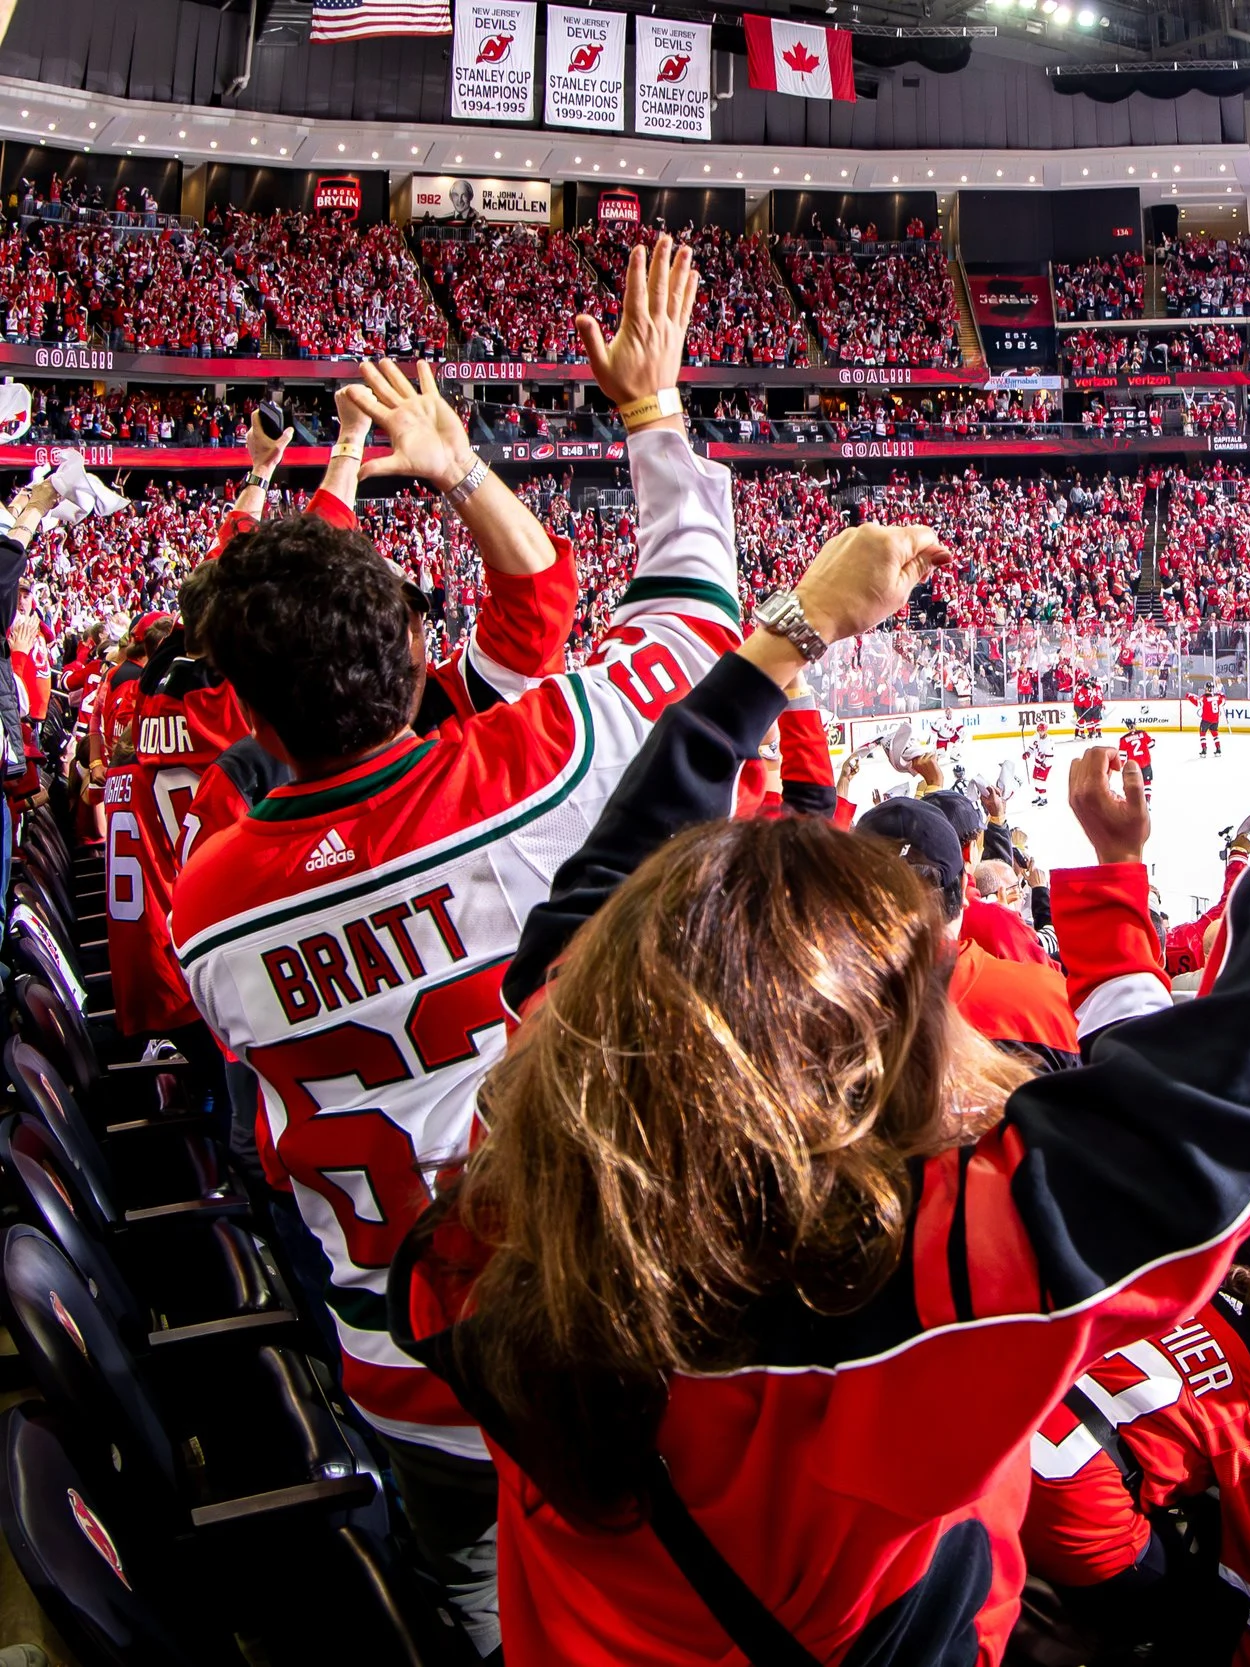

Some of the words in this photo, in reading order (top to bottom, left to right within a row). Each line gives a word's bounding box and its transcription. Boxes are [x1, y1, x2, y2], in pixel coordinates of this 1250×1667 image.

[472, 7, 493, 16] NEW
[495, 8, 521, 18] JERSEY
[475, 18, 516, 31] DEVILS
[563, 16, 583, 26] NEW
[584, 18, 610, 28] JERSEY
[567, 27, 607, 41] DEVILS
[651, 27, 669, 36] NEW
[670, 28, 696, 39] JERSEY
[655, 37, 692, 52] DEVILS
[455, 67, 505, 83] STANLEY
[508, 70, 531, 84] CUP
[458, 84, 528, 100] CHAMPIONS
[550, 76, 597, 94] STANLEY
[600, 80, 622, 94] CUP
[552, 92, 618, 109] CHAMPIONS
[639, 85, 685, 101] STANLEY
[688, 90, 709, 104] CUP
[461, 101, 525, 113] 1994-1995
[641, 101, 705, 119] CHAMPIONS
[555, 108, 615, 122] 1999-2000
[644, 116, 702, 132] 2002-2003
[317, 196, 358, 207] BRYLIN
[416, 193, 441, 205] 1982
[483, 190, 494, 199] DR.
[497, 191, 515, 200] JOHN
[518, 192, 525, 200] J.
[601, 207, 638, 220] LEMAIRE
[996, 341, 1038, 350] 1982
[35, 348, 113, 369] GOAL!!!
[444, 363, 523, 379] GOAL!!!
[839, 368, 911, 383] GOAL!!!
[1074, 376, 1118, 387] verizon
[1128, 375, 1171, 386] verizon
[517, 446, 525, 457] 0
[841, 441, 914, 457] GOAL!!!
[1131, 740, 1143, 756] 2
[108, 811, 145, 921] 6
[305, 849, 355, 872] adidas
[261, 884, 468, 1025] BRATT
